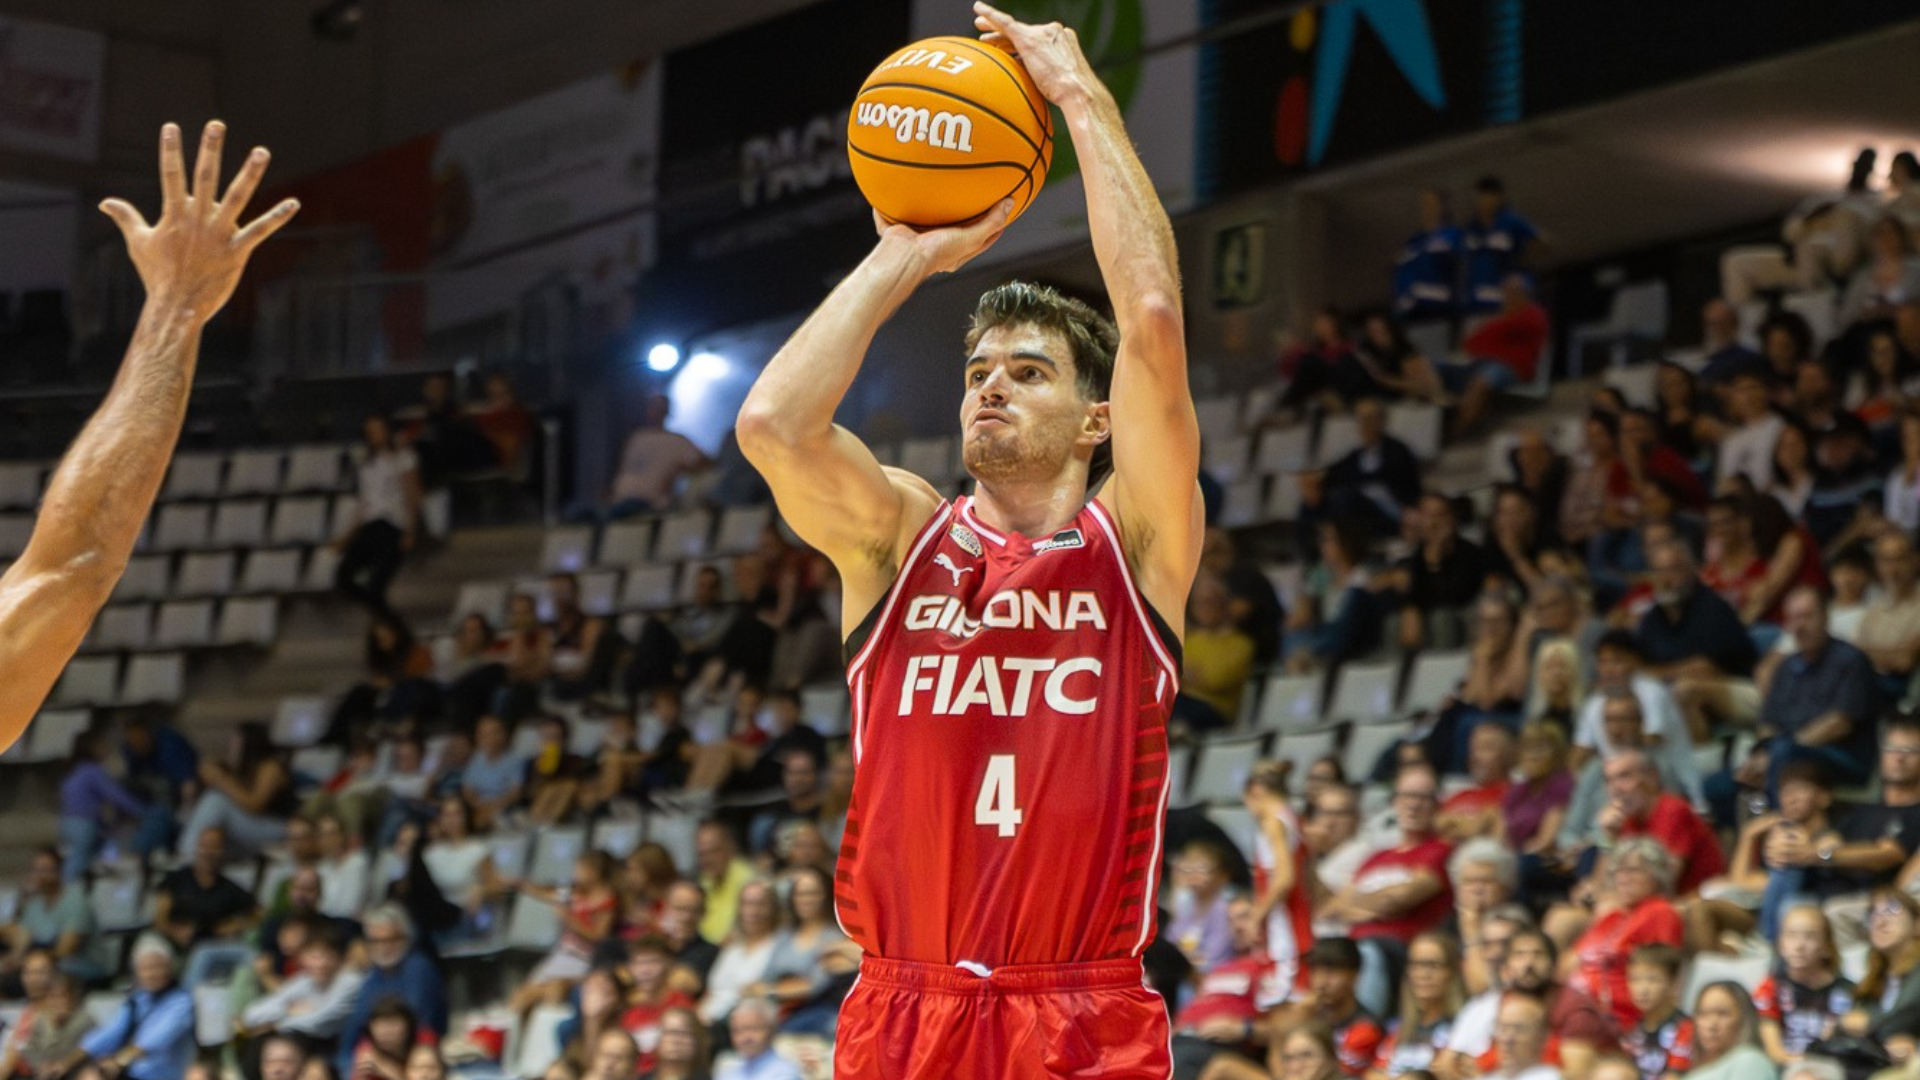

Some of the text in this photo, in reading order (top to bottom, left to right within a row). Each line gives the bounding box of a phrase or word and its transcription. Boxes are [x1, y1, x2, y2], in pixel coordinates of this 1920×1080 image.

[857, 102, 973, 153] Wilson
[897, 655, 1103, 717] FIATC
[975, 754, 1023, 838] 4
